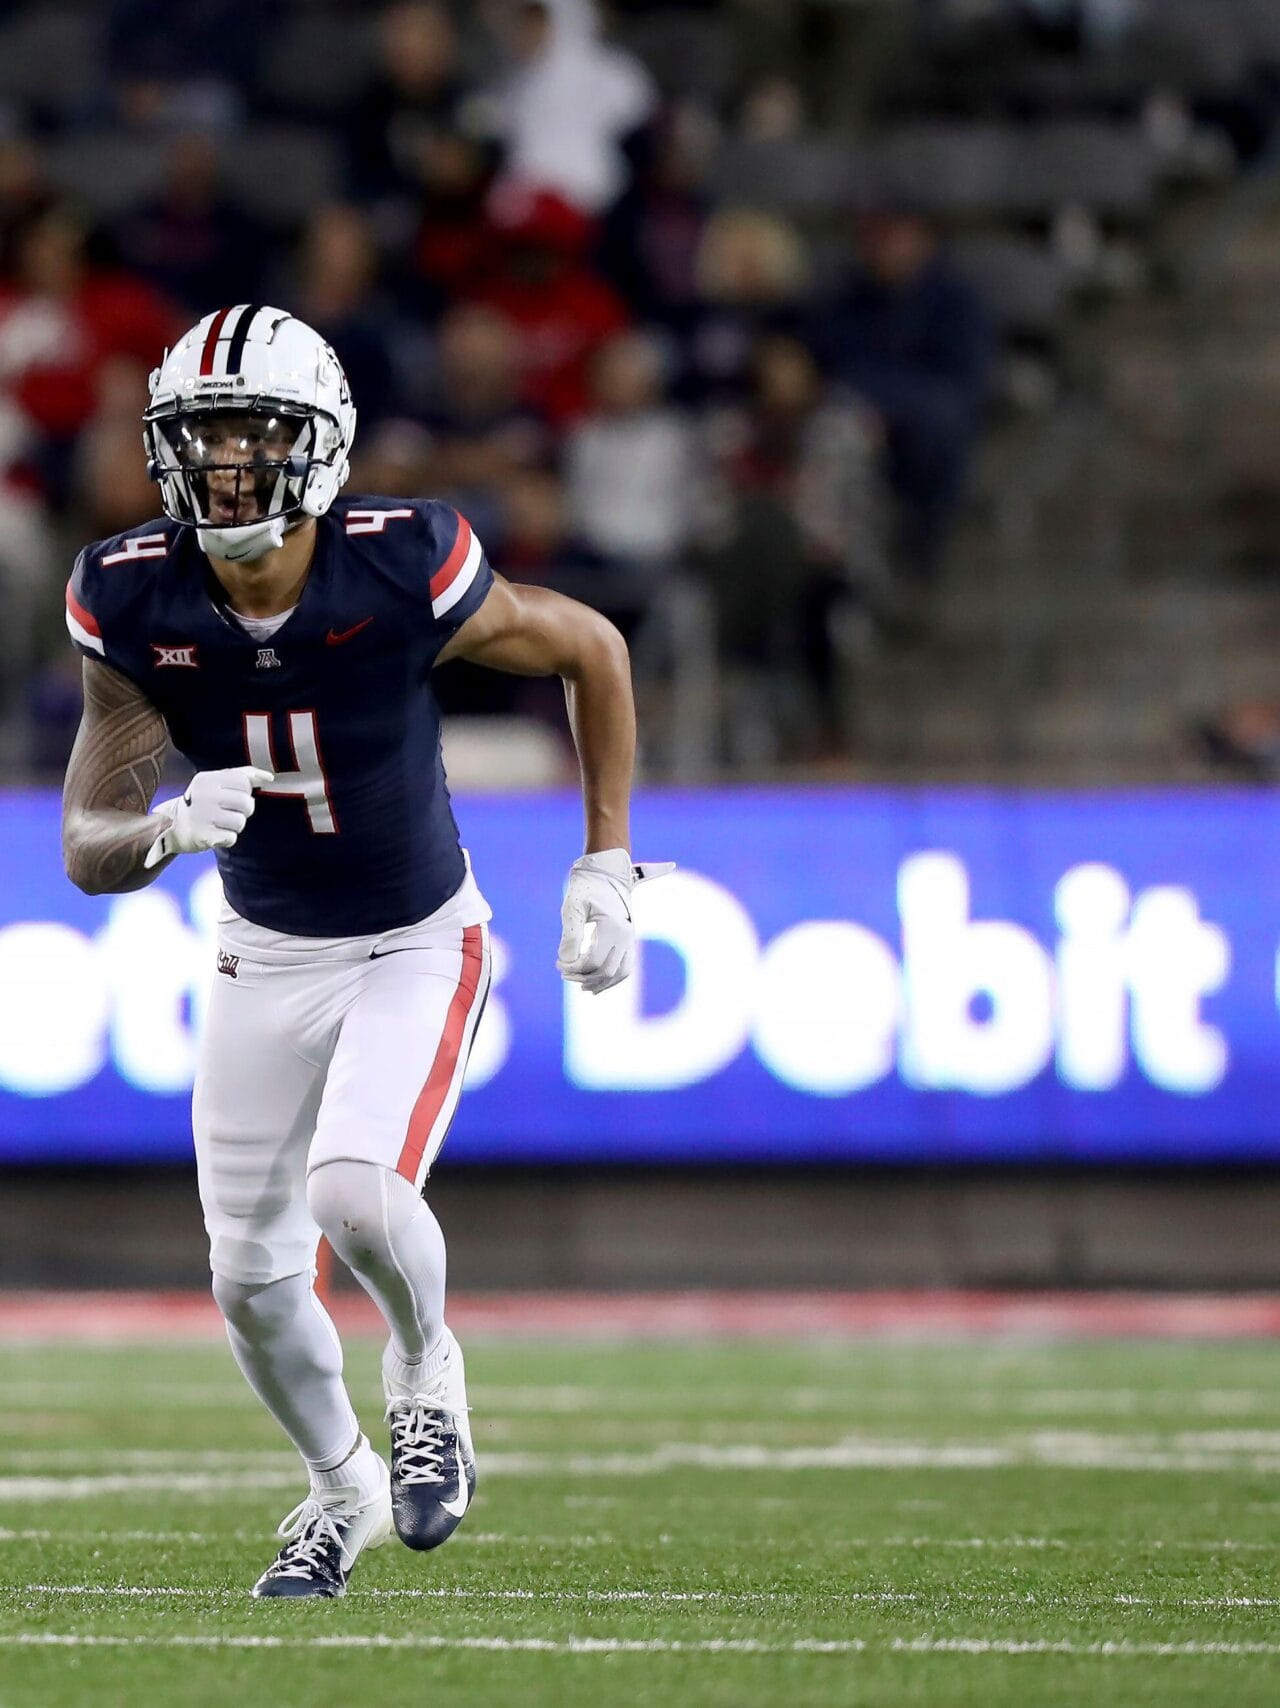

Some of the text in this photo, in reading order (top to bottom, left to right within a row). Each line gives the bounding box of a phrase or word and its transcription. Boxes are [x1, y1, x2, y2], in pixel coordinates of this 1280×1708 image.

[344, 507, 416, 536] 4
[101, 532, 168, 567] 4
[151, 645, 199, 668] XII
[241, 708, 341, 837] 4
[563, 851, 1231, 1098] Debit
